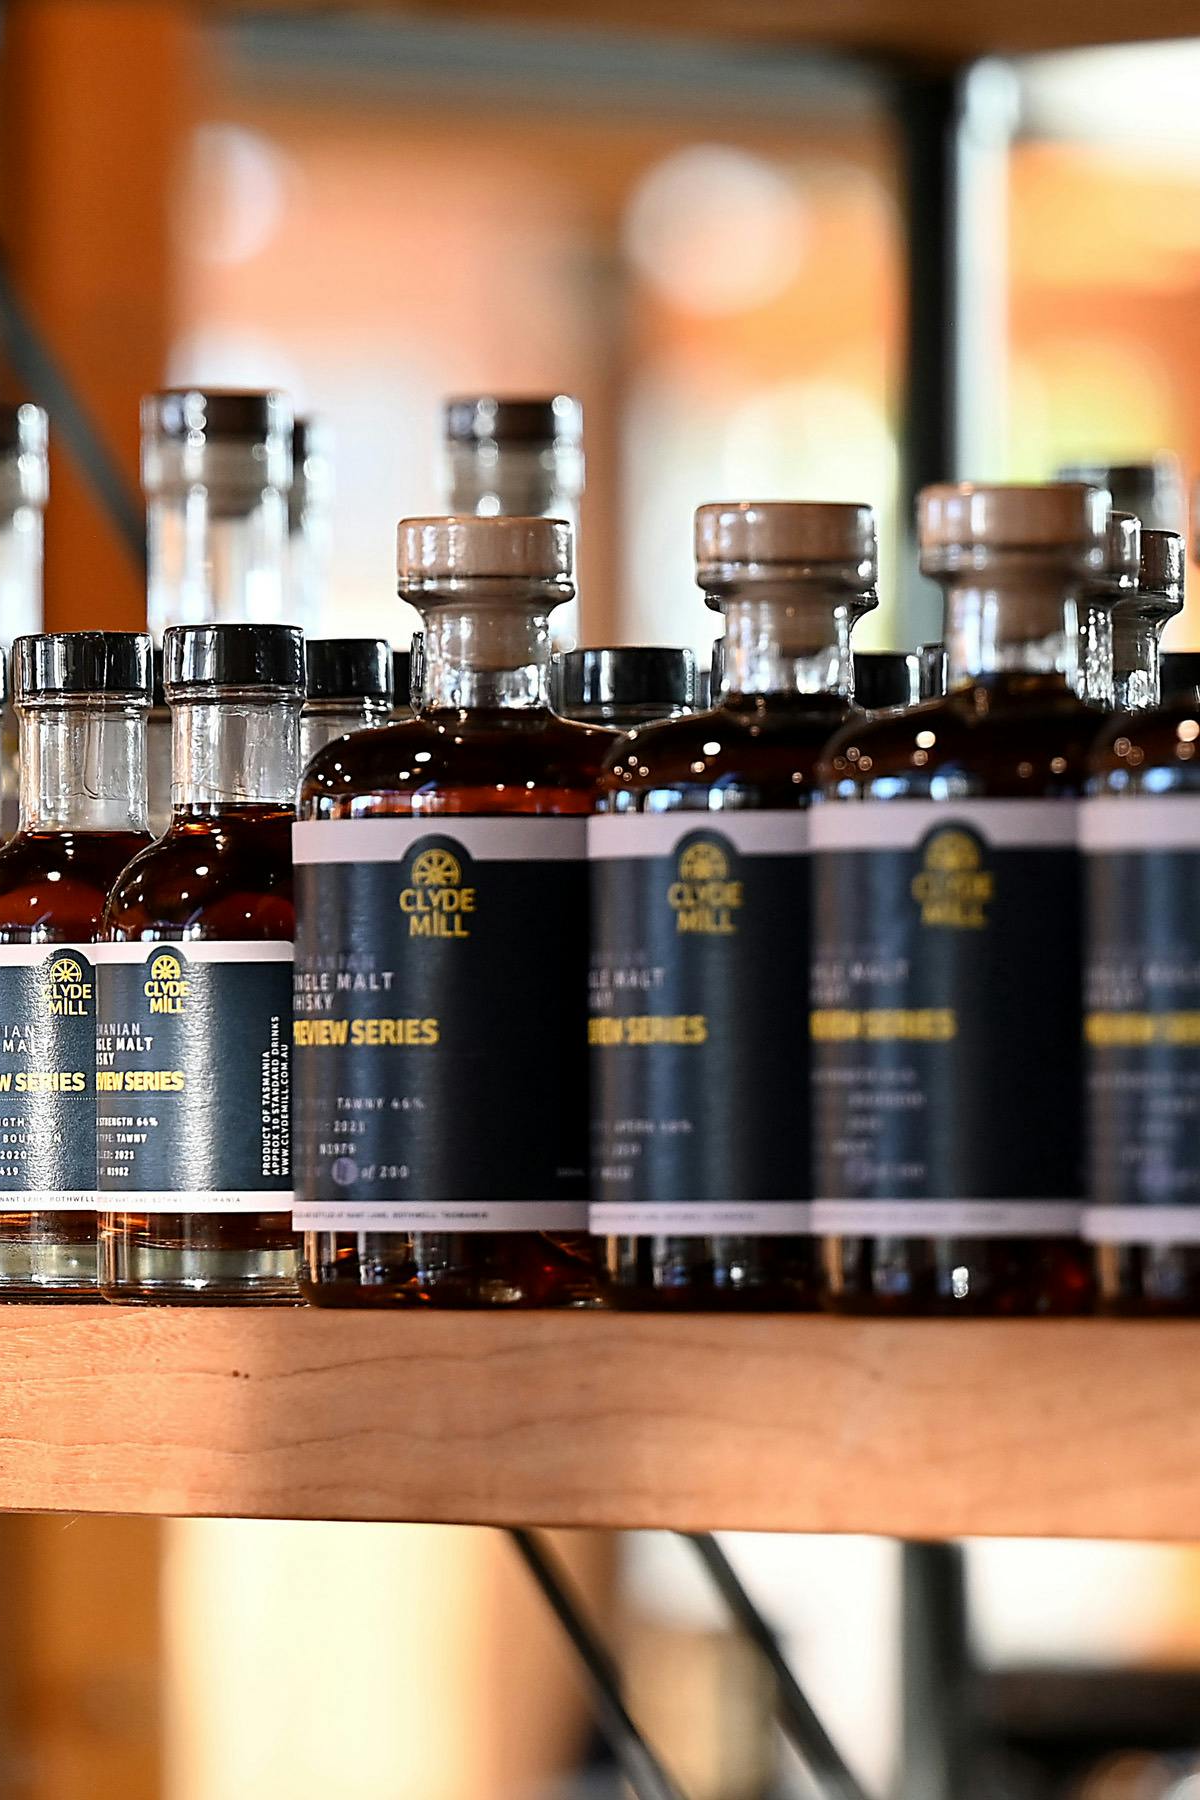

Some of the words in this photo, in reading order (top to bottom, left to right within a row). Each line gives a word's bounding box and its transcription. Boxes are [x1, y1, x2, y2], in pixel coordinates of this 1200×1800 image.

[399, 888, 477, 913] CLYDE
[667, 882, 744, 908] CLYDE
[409, 910, 470, 938] MILL
[677, 907, 737, 933] MILL
[144, 981, 190, 998] CLYDE
[336, 971, 394, 992] MALT
[49, 998, 89, 1016] MILL
[150, 996, 186, 1014] MILL
[271, 1016, 280, 1056] DRINKS
[350, 1017, 440, 1046] SERIES
[116, 1036, 153, 1052] MALT
[14, 1072, 86, 1093] SERIES
[124, 1071, 185, 1092] SERIES
[262, 1051, 271, 1106] TASMANIA
[271, 1059, 280, 1115] STANDARD
[281, 1044, 289, 1176] WWW.CLYDEMILL.COM.AU
[336, 1096, 385, 1110] TAWNY
[99, 1117, 133, 1127] STRENGTH
[262, 1109, 271, 1122] OF
[271, 1119, 280, 1130] 10
[116, 1133, 147, 1143] TAWNY
[0, 1150, 27, 1160] 2020
[262, 1126, 271, 1176] PRODUCT
[271, 1132, 280, 1176] APPROX
